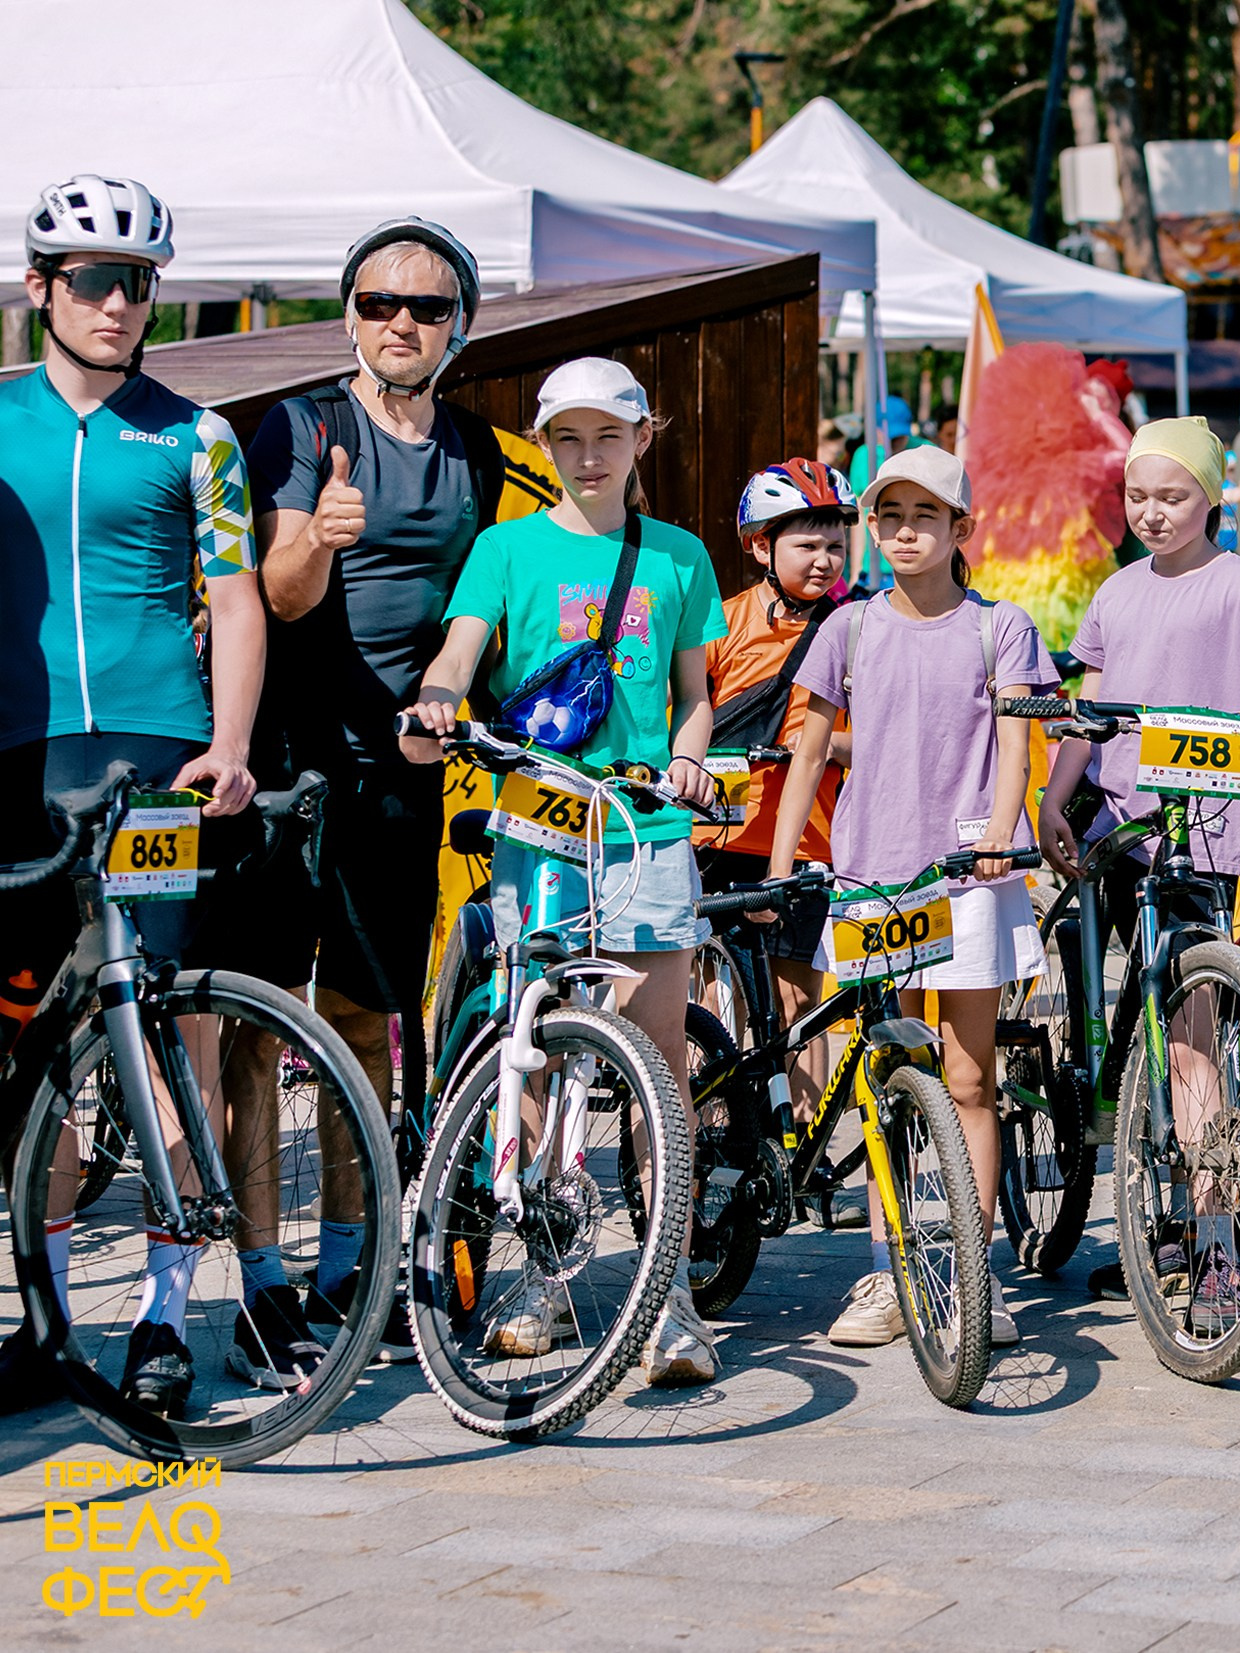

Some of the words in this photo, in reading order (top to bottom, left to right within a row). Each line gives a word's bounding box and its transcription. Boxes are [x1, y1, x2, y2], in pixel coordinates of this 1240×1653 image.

[119, 429, 179, 447] BRIKO
[1169, 733, 1231, 768] 758
[530, 787, 590, 834] 763
[130, 833, 178, 869] 863
[862, 911, 930, 954] 800
